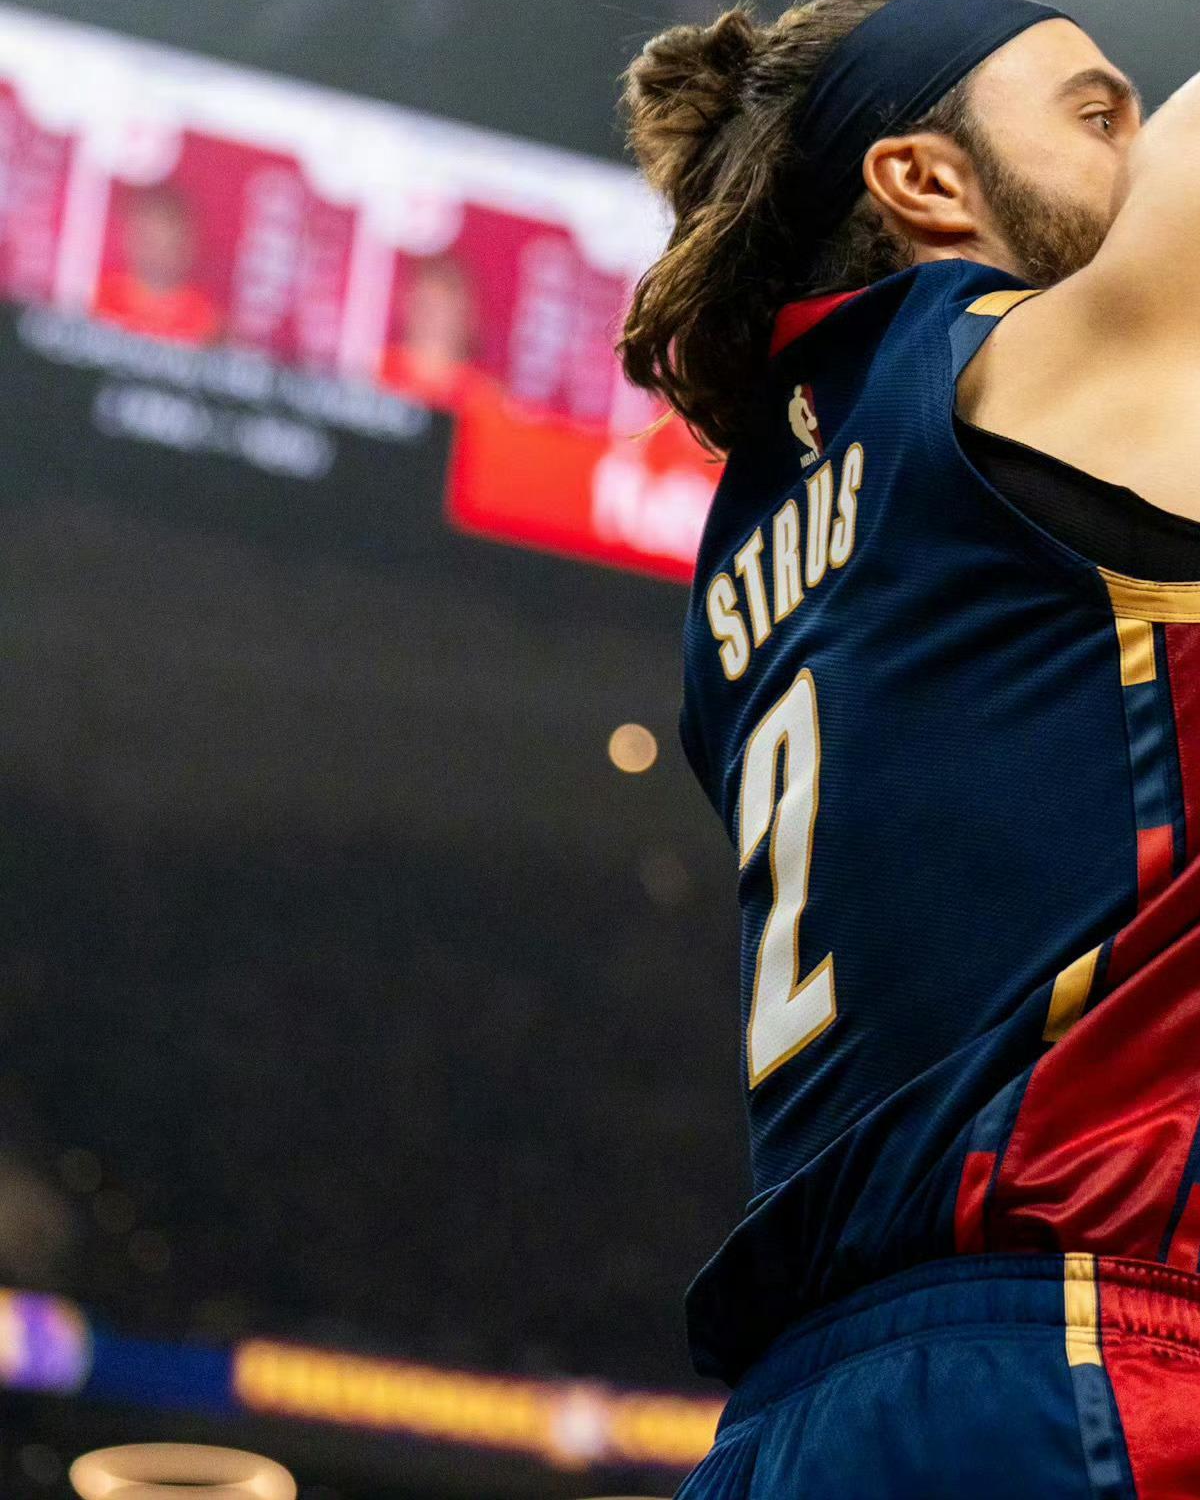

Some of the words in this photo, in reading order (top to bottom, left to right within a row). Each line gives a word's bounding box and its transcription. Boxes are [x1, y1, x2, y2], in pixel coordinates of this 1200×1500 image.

[706, 442, 864, 681] STRUS
[800, 450, 818, 468] NBA
[738, 667, 838, 1091] 2
